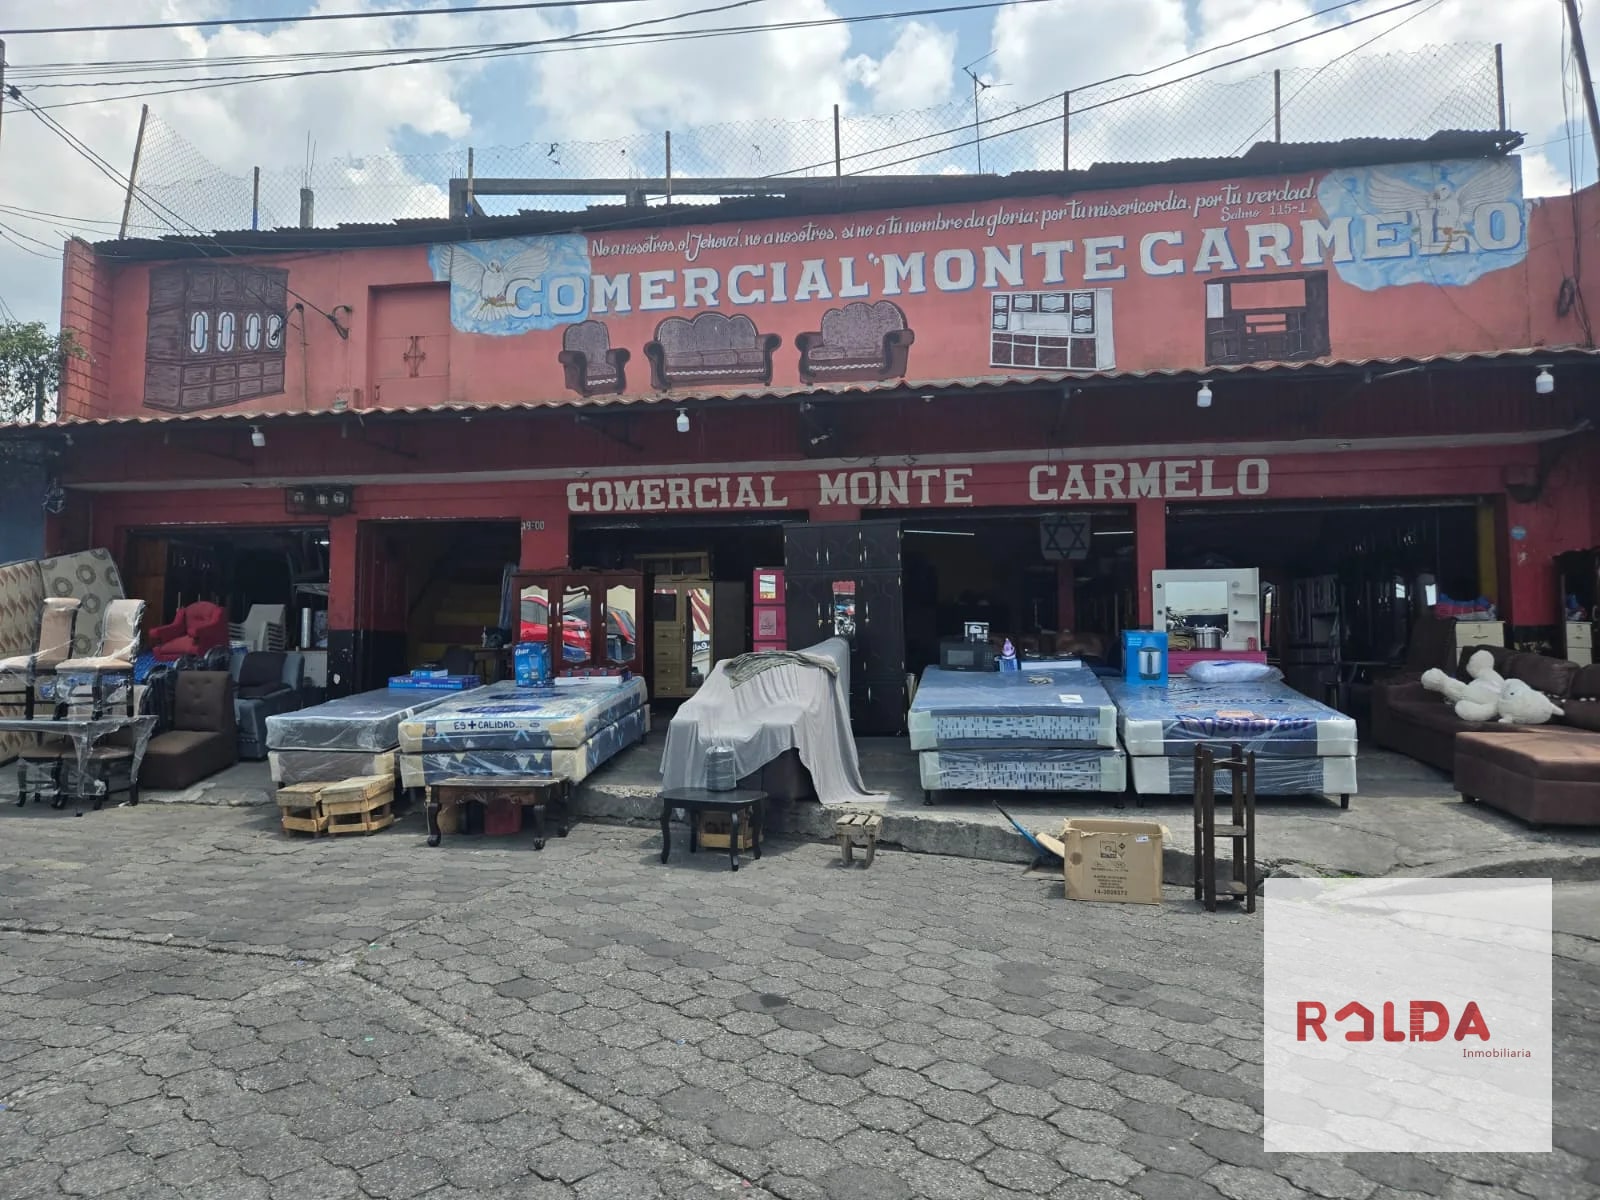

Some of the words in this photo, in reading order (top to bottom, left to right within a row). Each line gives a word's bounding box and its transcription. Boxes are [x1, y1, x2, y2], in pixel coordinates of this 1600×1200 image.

[745, 232, 761, 246] no
[856, 224, 874, 237] no
[905, 211, 962, 234] nombre
[964, 209, 984, 229] da
[1040, 208, 1067, 230] por
[1065, 199, 1085, 219] tu
[1193, 194, 1222, 218] por
[1221, 184, 1241, 205] tu
[1220, 206, 1261, 222] Salmo
[505, 255, 869, 319] COMERCIAL
[566, 475, 788, 512] COMERCIAL
[817, 467, 974, 506] MONTE
[1028, 458, 1270, 502] CARMELO
